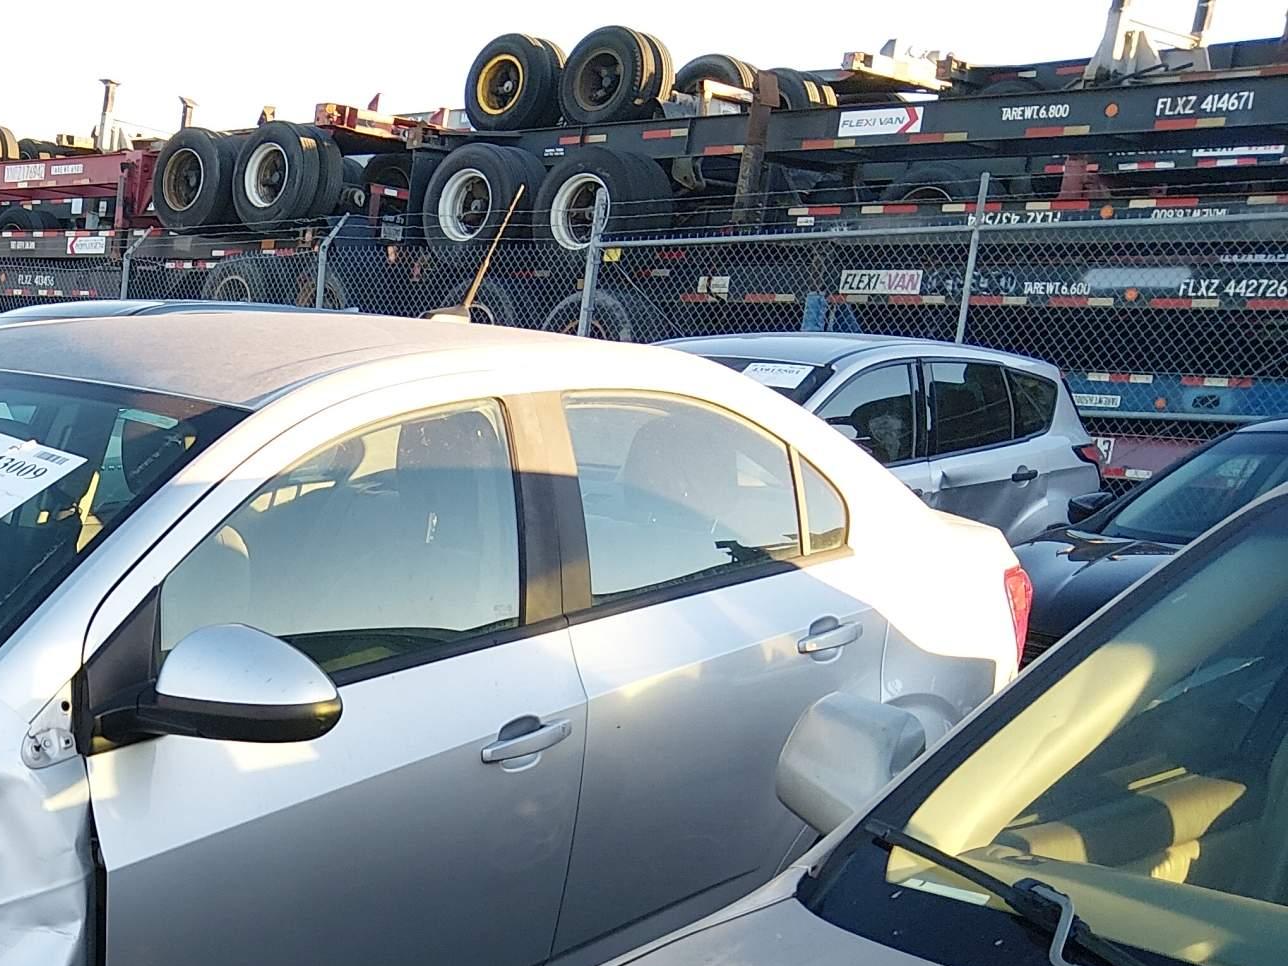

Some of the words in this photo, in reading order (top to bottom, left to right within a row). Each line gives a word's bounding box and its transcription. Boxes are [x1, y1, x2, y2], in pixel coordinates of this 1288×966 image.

[1156, 95, 1197, 117] FLXZ
[1200, 91, 1255, 113] 414671
[841, 117, 878, 129] FLEXI
[879, 115, 906, 127] VAN
[1178, 278, 1220, 297] FLXZ
[1224, 278, 1288, 298] 442726
